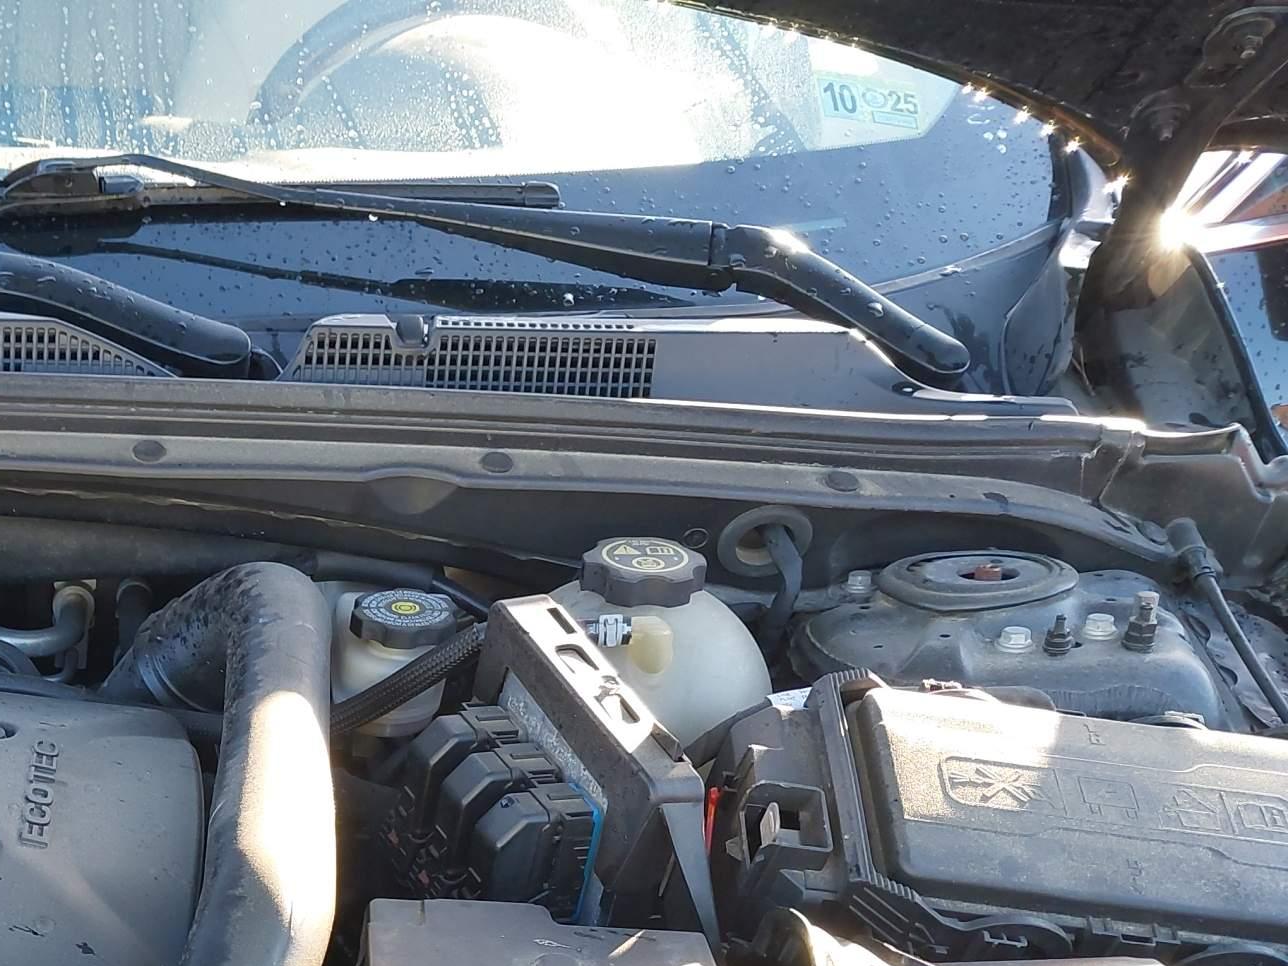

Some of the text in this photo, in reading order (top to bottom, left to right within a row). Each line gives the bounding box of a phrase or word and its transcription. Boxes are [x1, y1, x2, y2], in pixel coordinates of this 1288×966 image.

[823, 82, 919, 115] 10 25
[18, 740, 59, 849] ECOTEC
